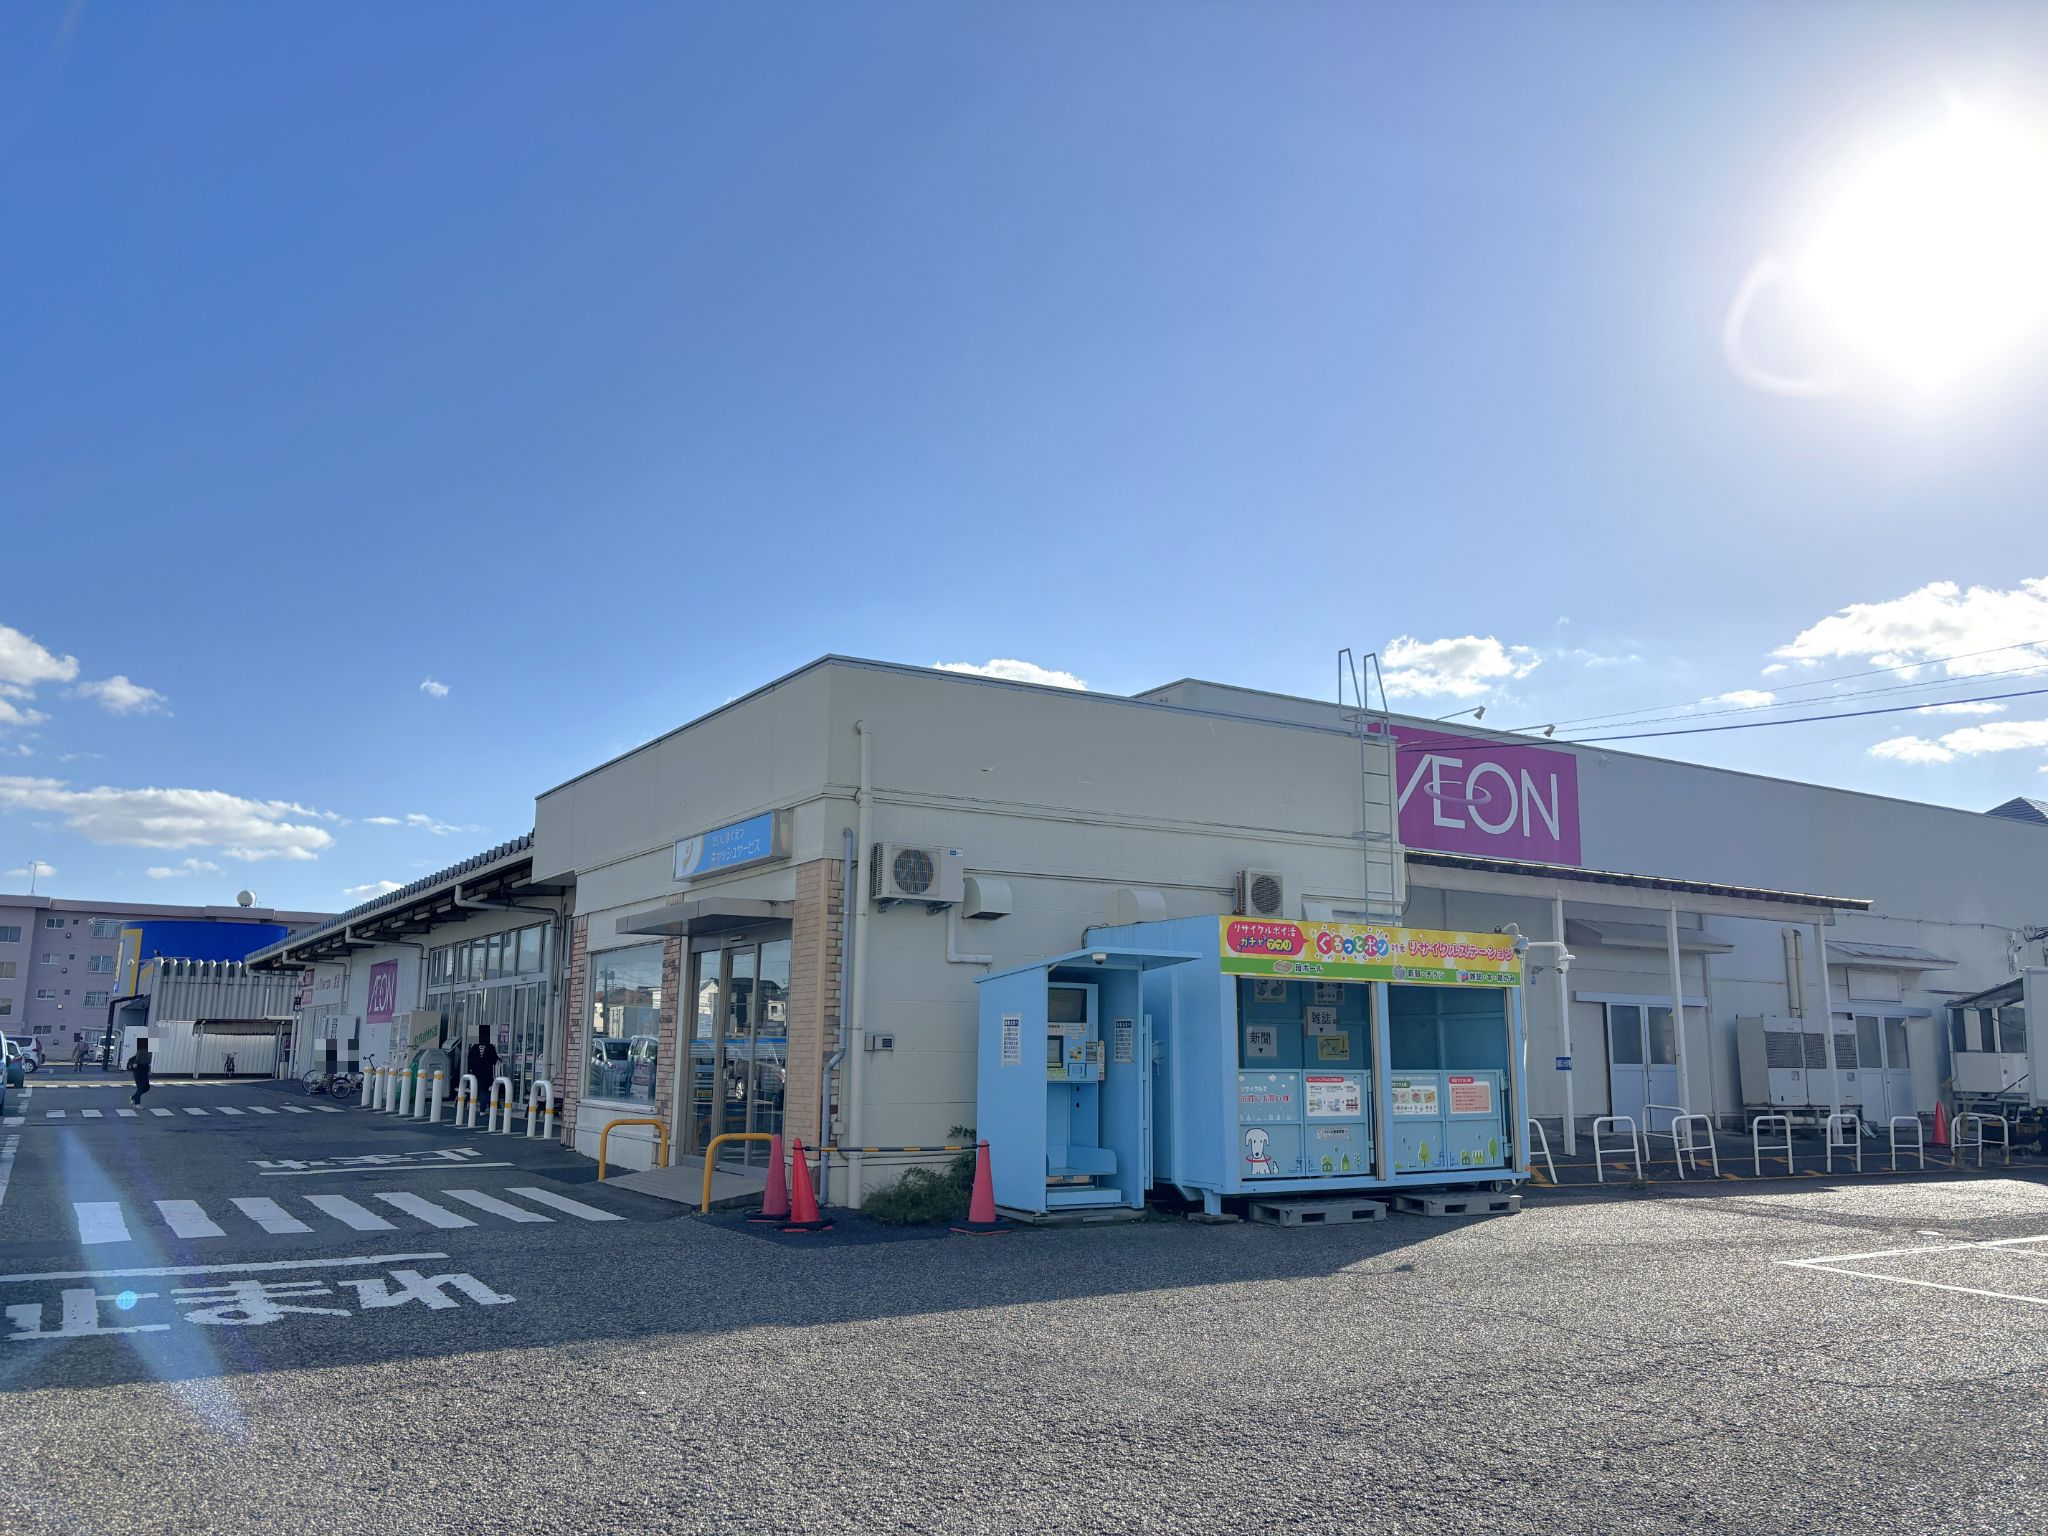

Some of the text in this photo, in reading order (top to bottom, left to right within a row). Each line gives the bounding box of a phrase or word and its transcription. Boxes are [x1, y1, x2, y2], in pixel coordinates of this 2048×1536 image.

[711, 839, 760, 864] キャッシュサービス
[1234, 924, 1297, 937] リサイクルポイ活
[1317, 932, 1389, 956] ぐるっとポン
[1408, 939, 1514, 962] リサイクルステーション
[1311, 1012, 1331, 1025] 雑誌
[1250, 1031, 1271, 1046] 新聞
[4, 1268, 518, 1341] 止まれ
